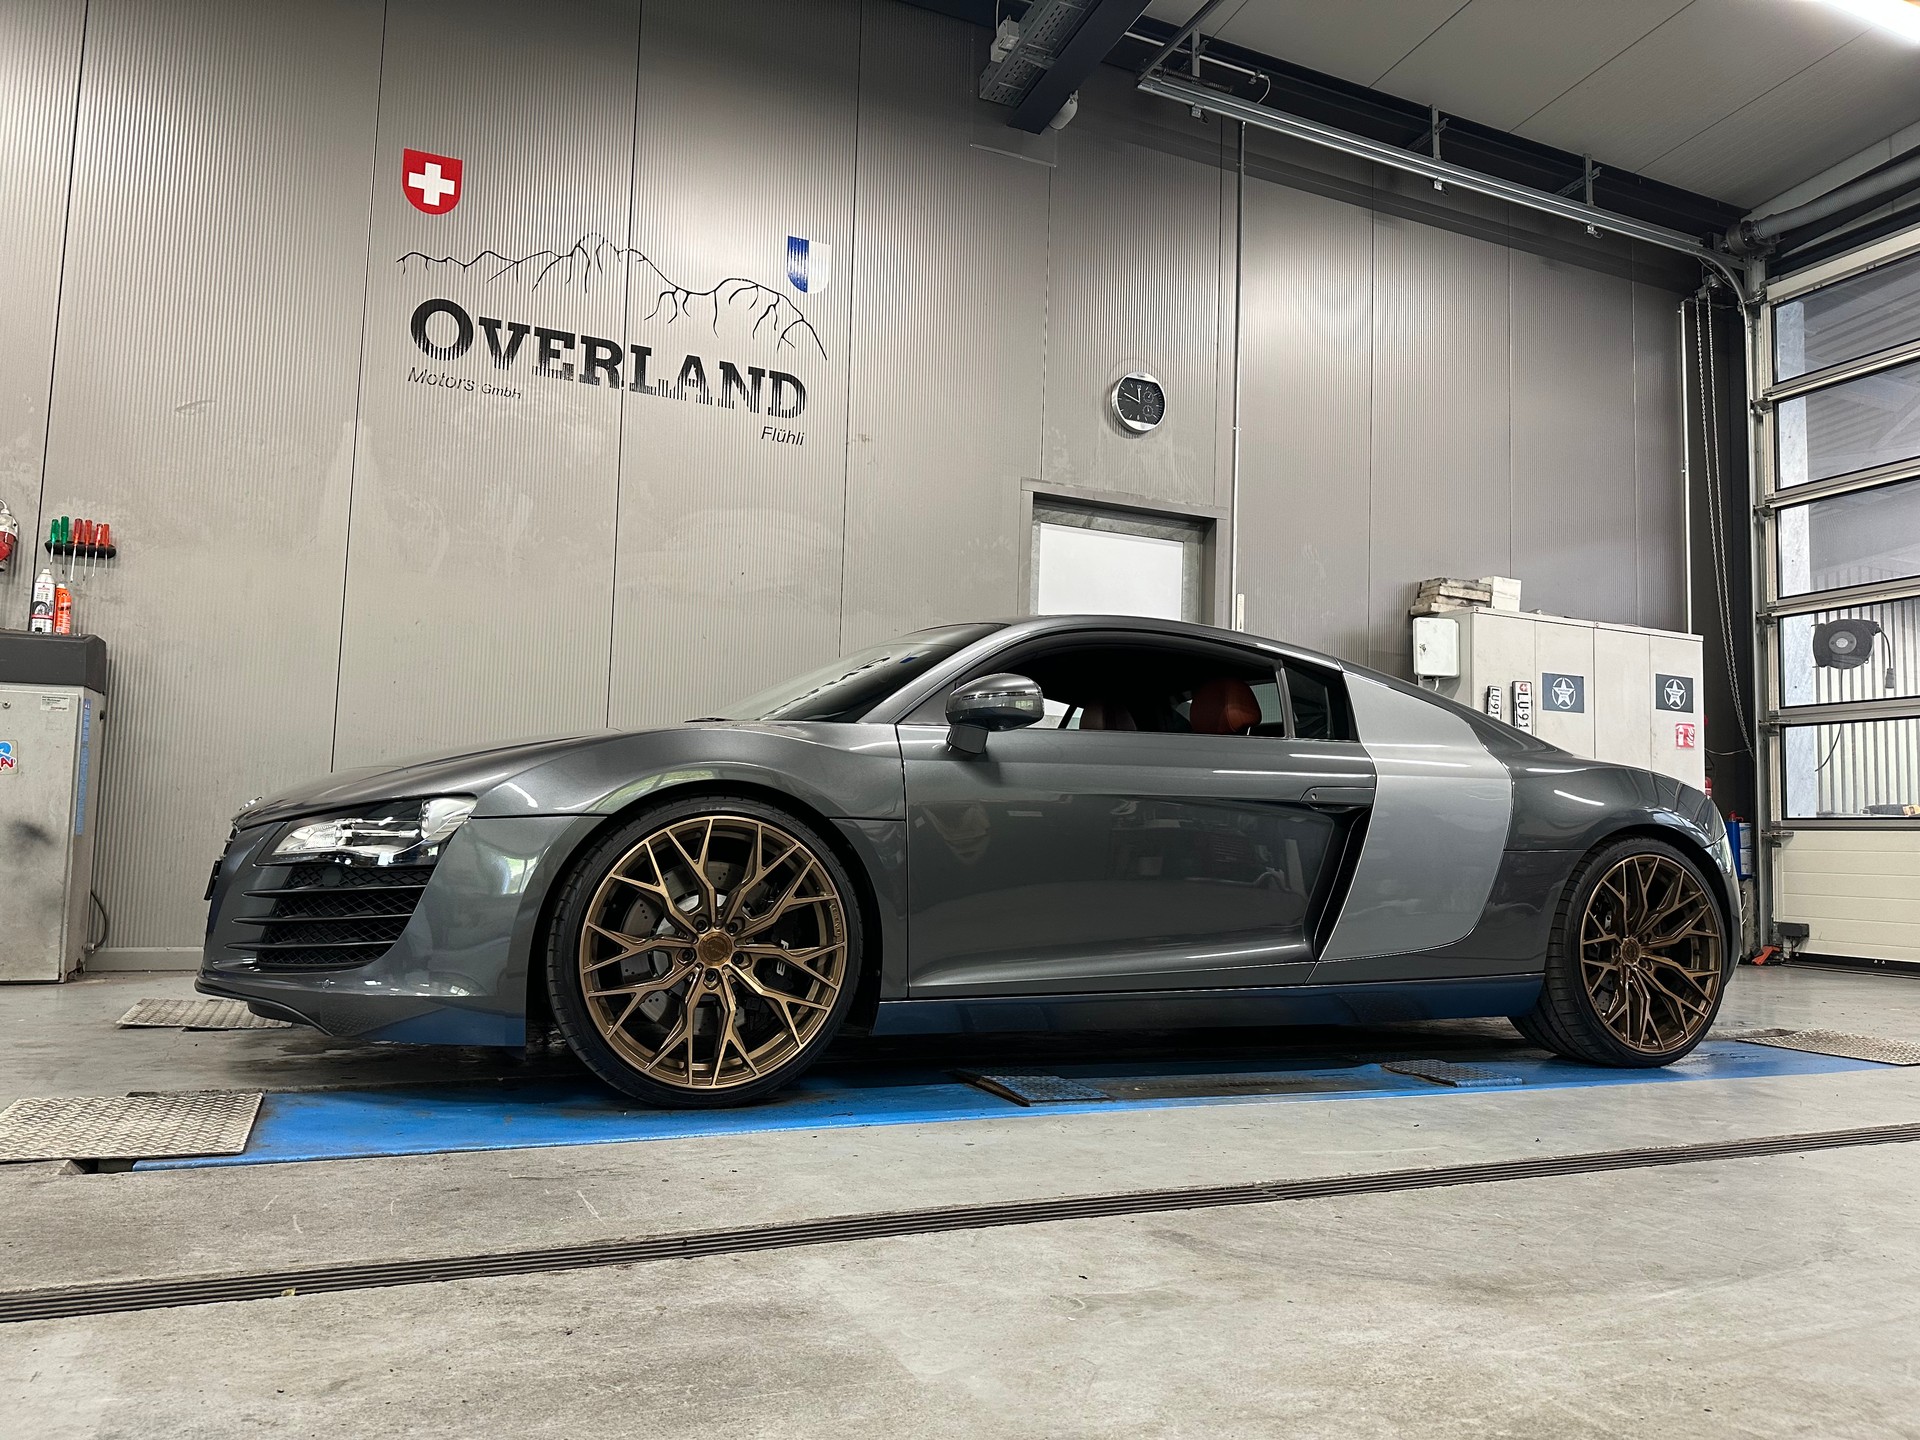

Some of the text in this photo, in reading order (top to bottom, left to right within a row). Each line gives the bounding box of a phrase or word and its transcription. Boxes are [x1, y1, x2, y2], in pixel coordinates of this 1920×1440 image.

[410, 298, 808, 419] OVERLAND
[407, 366, 475, 392] Motors
[761, 426, 805, 446] Flühli
